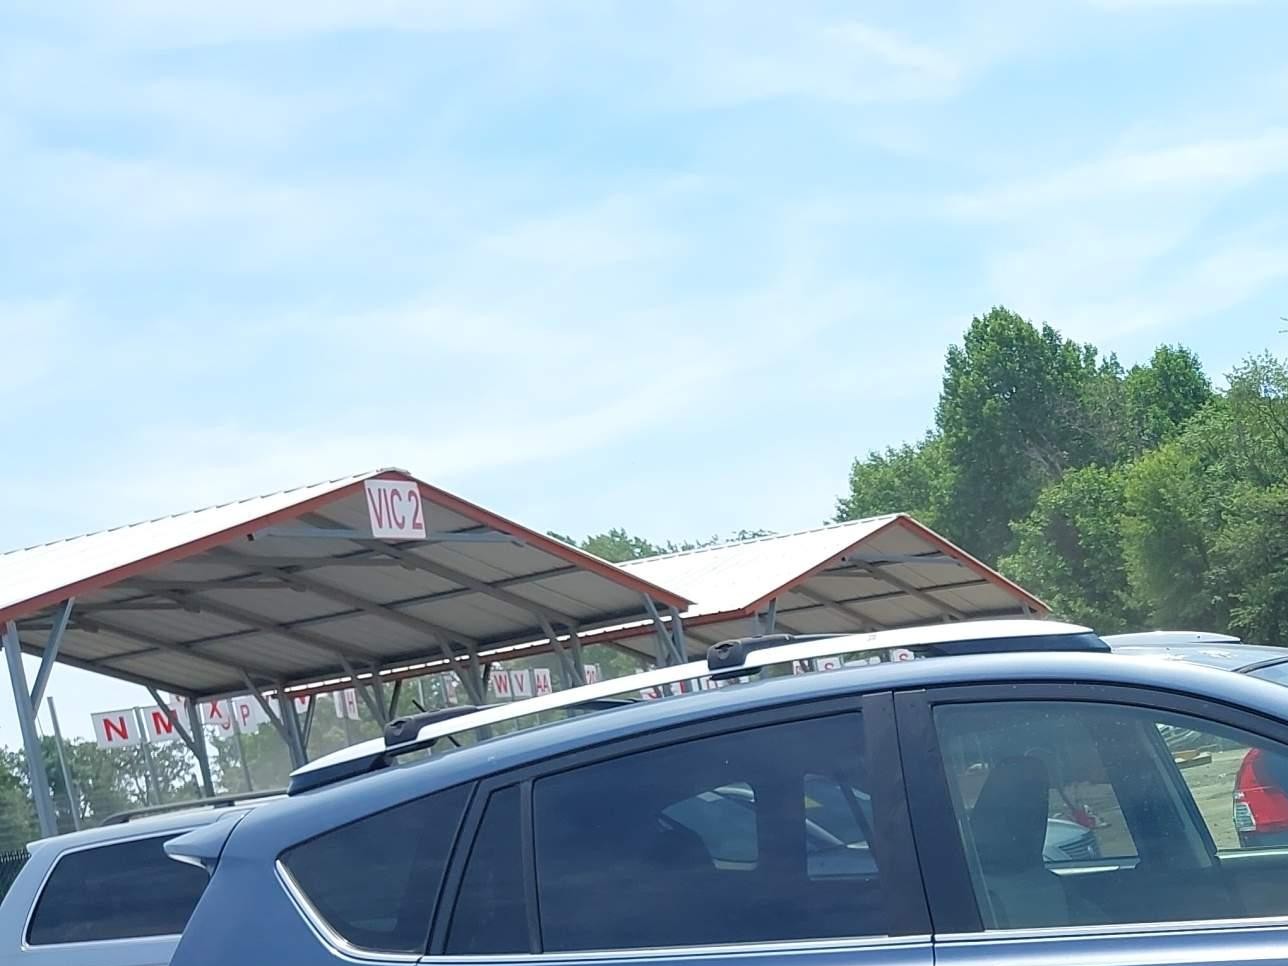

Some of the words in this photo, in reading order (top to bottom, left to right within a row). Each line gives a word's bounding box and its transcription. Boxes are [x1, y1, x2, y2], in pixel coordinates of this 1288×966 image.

[367, 488, 405, 530] VIC
[408, 489, 423, 530] 2
[494, 674, 508, 694] W
[514, 673, 524, 693] V
[240, 704, 250, 727] P
[102, 716, 129, 742] N
